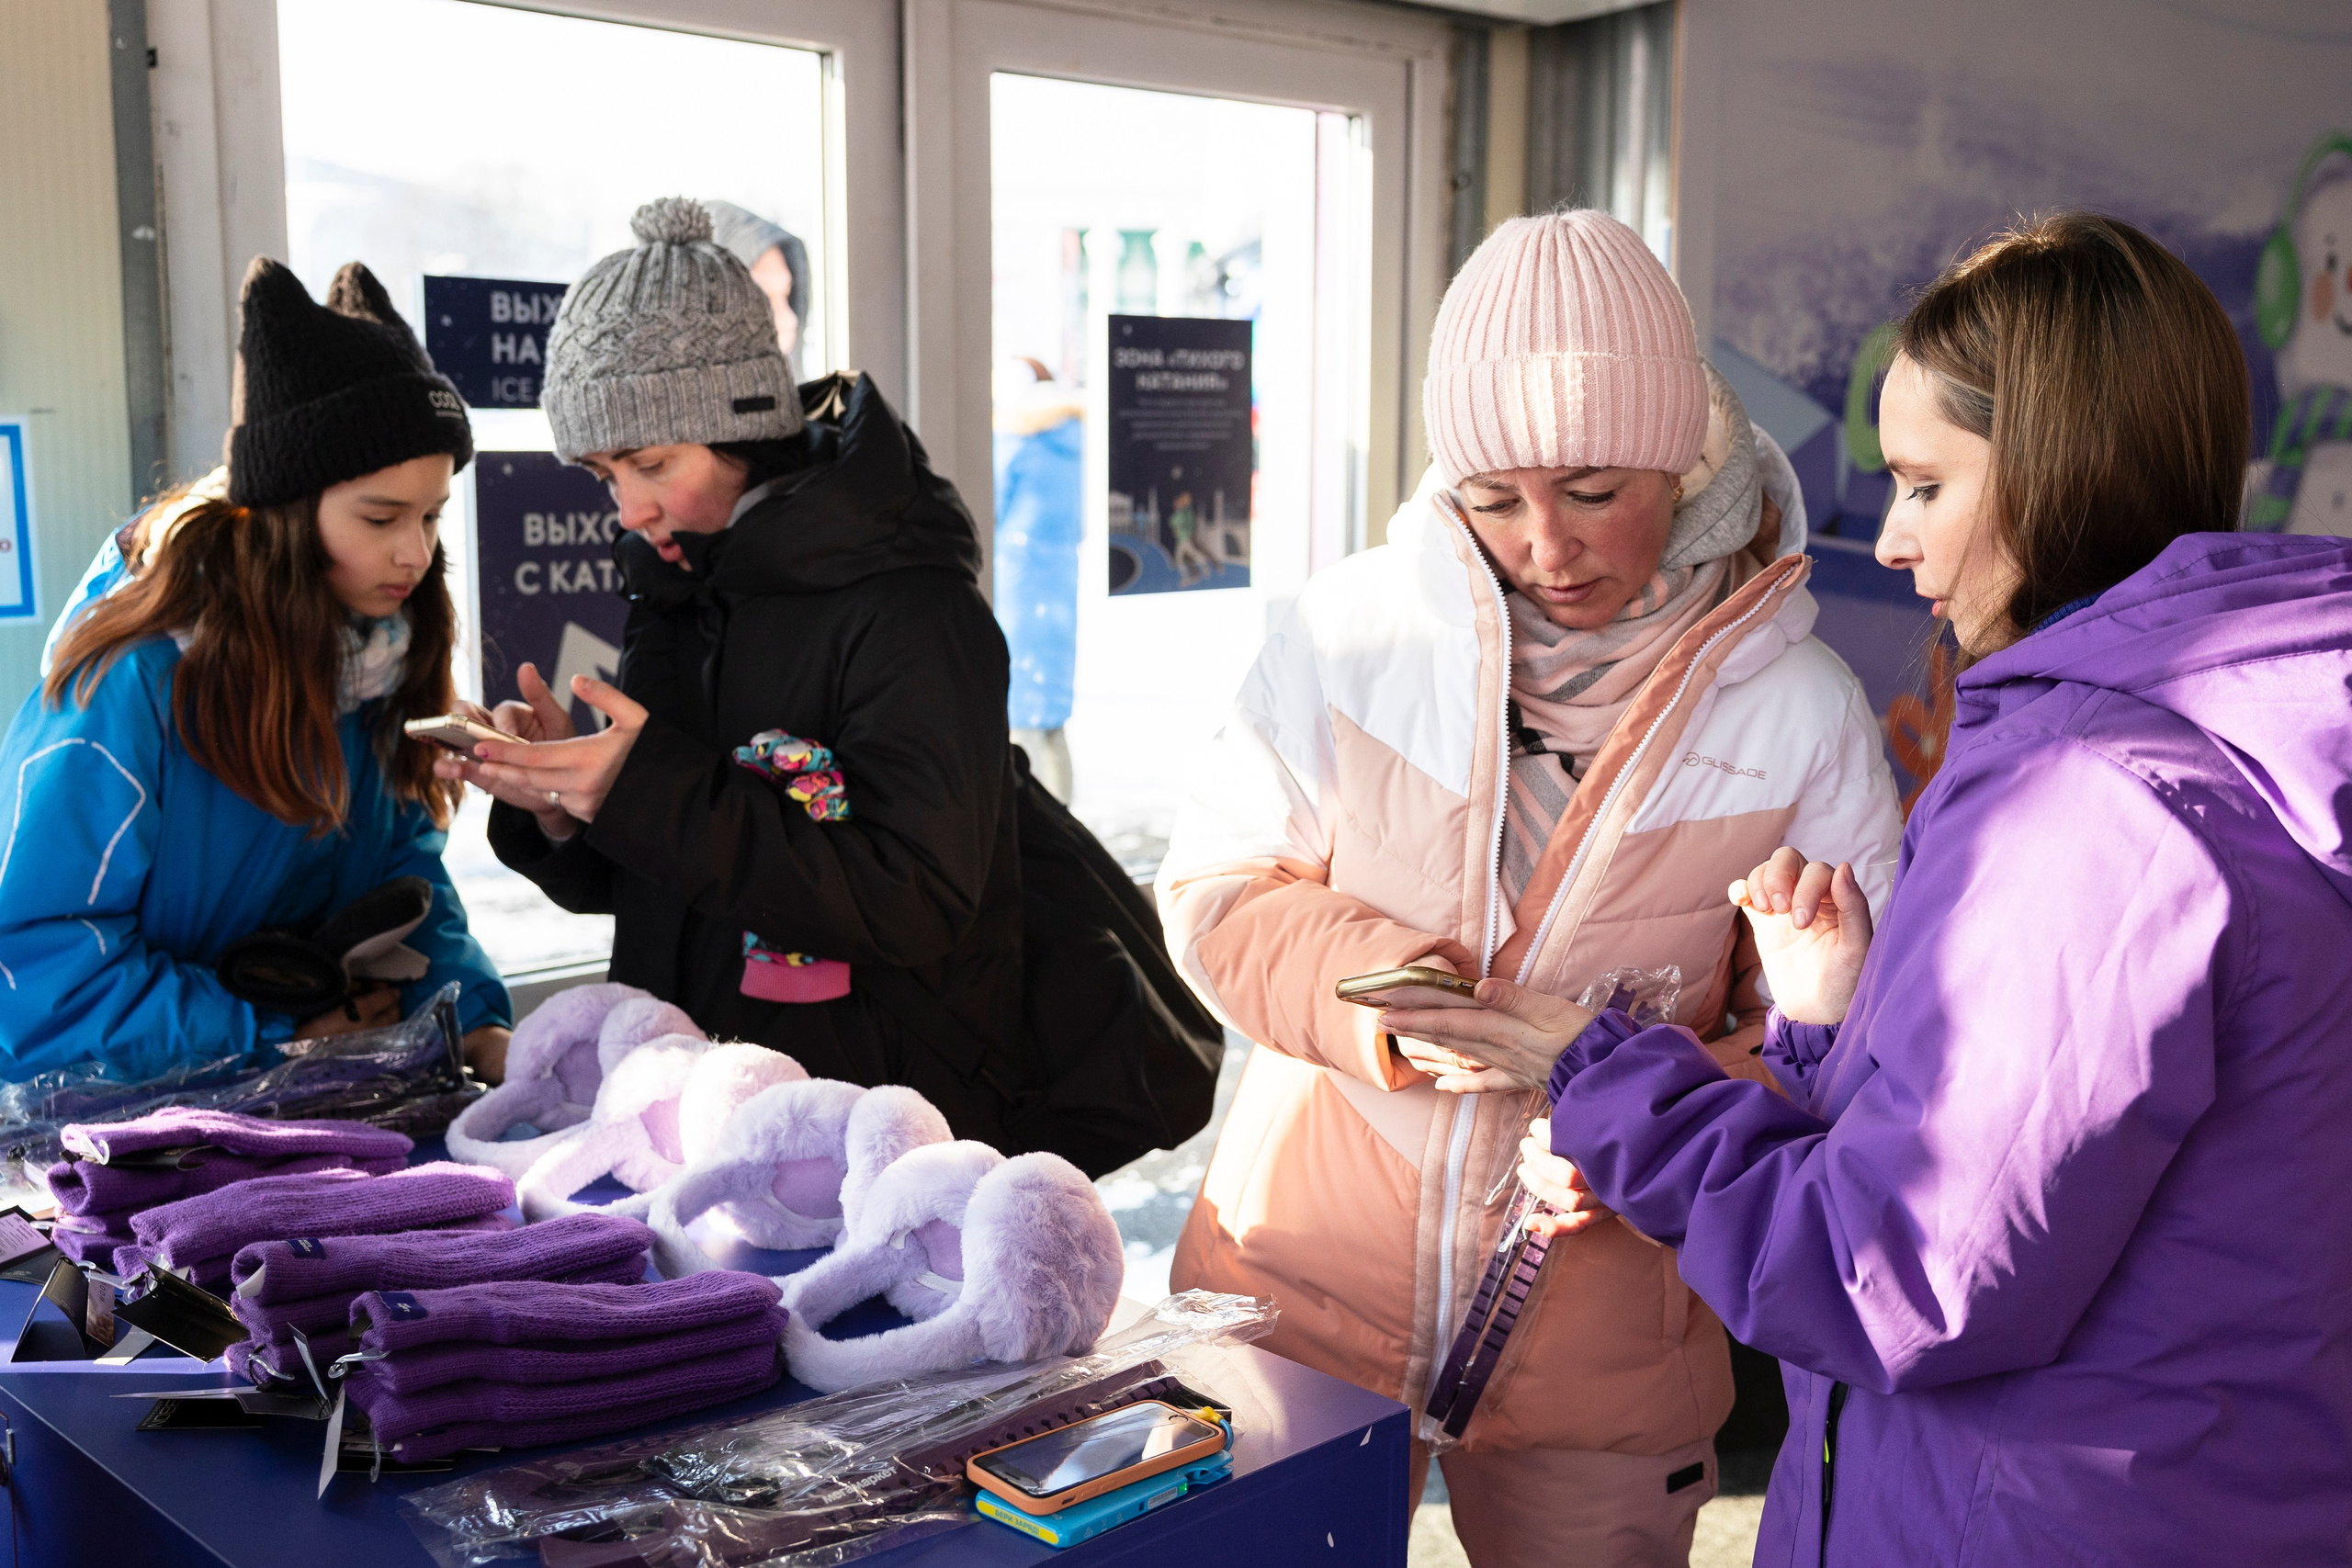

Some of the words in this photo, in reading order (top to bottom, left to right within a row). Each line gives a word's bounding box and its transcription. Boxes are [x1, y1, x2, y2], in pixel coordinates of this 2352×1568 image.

[492, 333, 541, 365] НА
[1113, 347, 1164, 368] ЗОНА
[492, 376, 534, 402] ICE
[514, 560, 540, 595] С
[548, 558, 625, 593] КАТ
[1702, 756, 1767, 780] GLISSADE
[822, 1466, 898, 1505] мегамаркет
[995, 1509, 1013, 1523] БЕРИ
